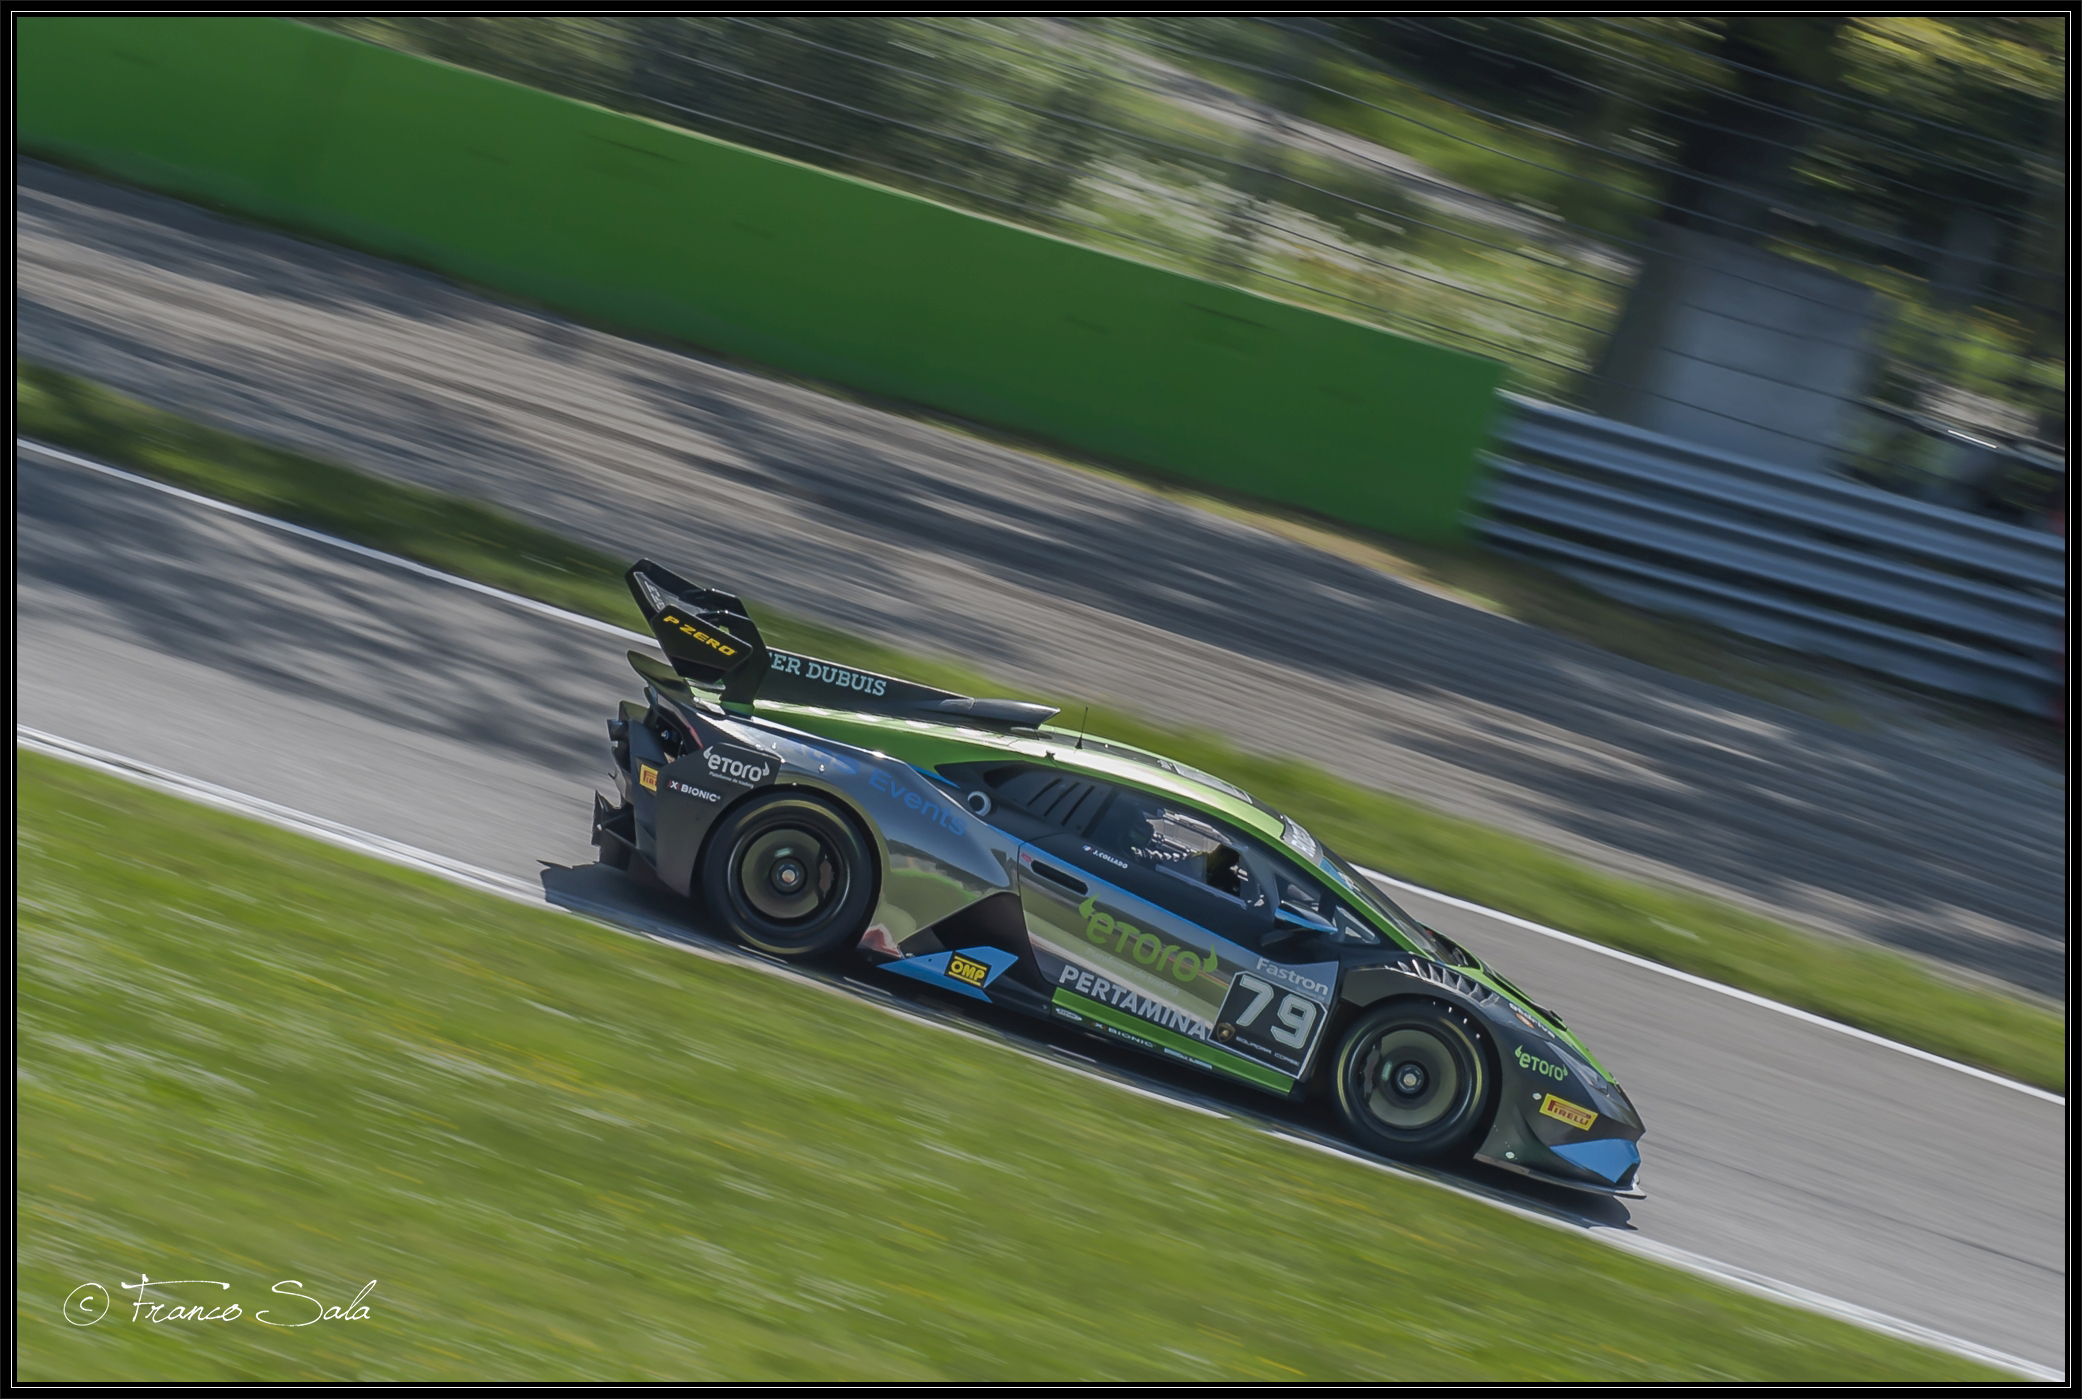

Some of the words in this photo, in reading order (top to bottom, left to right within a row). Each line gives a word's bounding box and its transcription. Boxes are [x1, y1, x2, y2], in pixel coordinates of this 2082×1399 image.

[663, 615, 680, 625] P
[679, 623, 737, 656] ZERO
[768, 652, 801, 675] ER
[805, 661, 887, 696] DUBUIS
[868, 768, 968, 836] Events
[1092, 849, 1128, 869] J.COLLADO
[950, 960, 985, 981] OMP
[1256, 956, 1329, 996] Fastron
[1058, 964, 1206, 1041] PERTAMINA
[1235, 974, 1317, 1050] 79
[1546, 1099, 1592, 1126] PIRELLI
